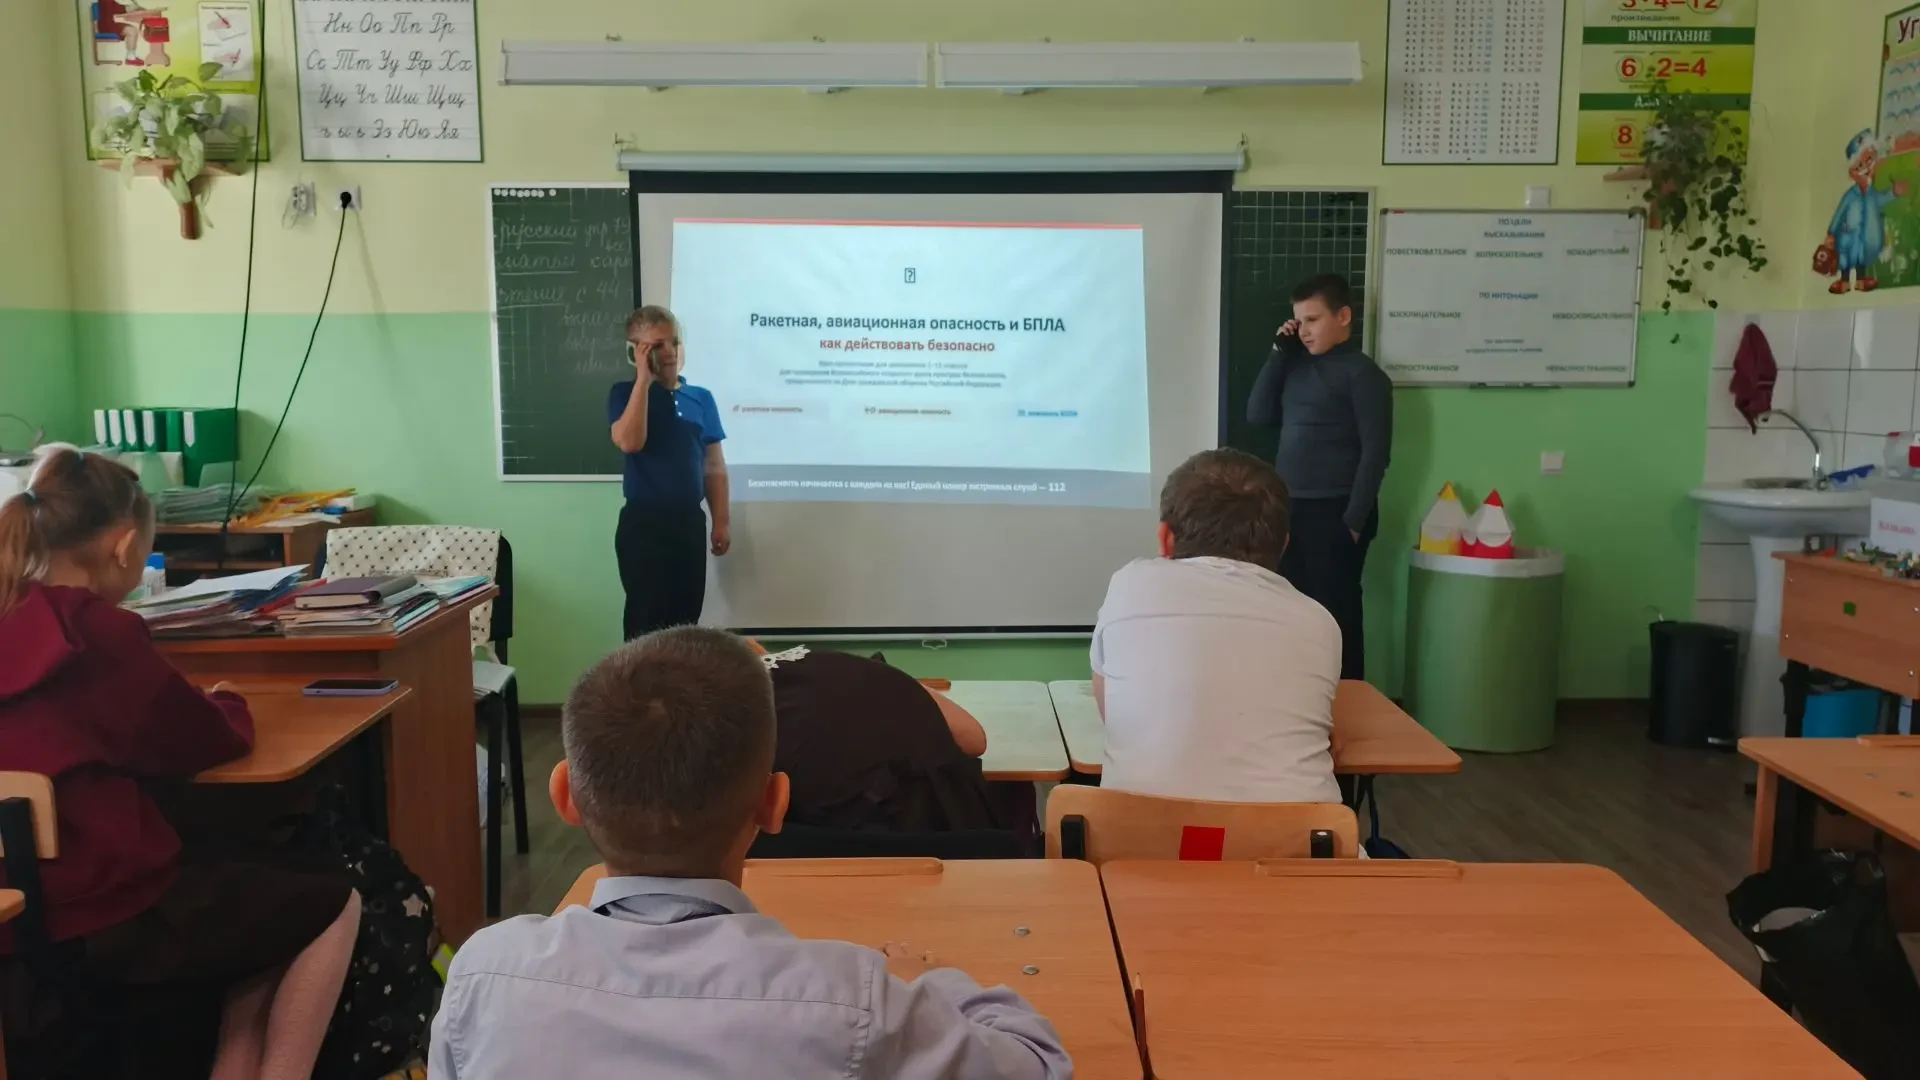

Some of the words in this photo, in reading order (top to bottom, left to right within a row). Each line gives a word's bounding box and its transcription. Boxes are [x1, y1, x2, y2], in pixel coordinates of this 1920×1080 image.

[323, 12, 352, 34] Нн
[359, 12, 383, 34] Оо
[389, 12, 423, 34] Пп
[429, 12, 455, 42] Рр
[1627, 29, 1712, 42] ВЫЧИТАНИЕ
[1897, 16, 1920, 44] Уг
[306, 49, 328, 71] Сс
[332, 49, 373, 71] Тт
[378, 49, 401, 78] Уу
[405, 50, 433, 78] Фф
[438, 50, 473, 72] Хх
[318, 83, 348, 109] Цц
[384, 83, 419, 105] Шш
[426, 84, 467, 109] Щщ
[397, 118, 431, 139] Юю
[434, 118, 460, 139] Яя
[1616, 125, 1633, 144] 8
[749, 313, 823, 330] Ракетная,
[826, 316, 926, 331] авиационная
[930, 318, 1006, 332] опасность
[1009, 320, 1019, 331] и
[1023, 318, 1066, 332] БПЛА
[819, 338, 841, 349] как
[844, 338, 925, 351] действовать
[927, 339, 996, 352] безопасно
[1048, 482, 1066, 492] 112
